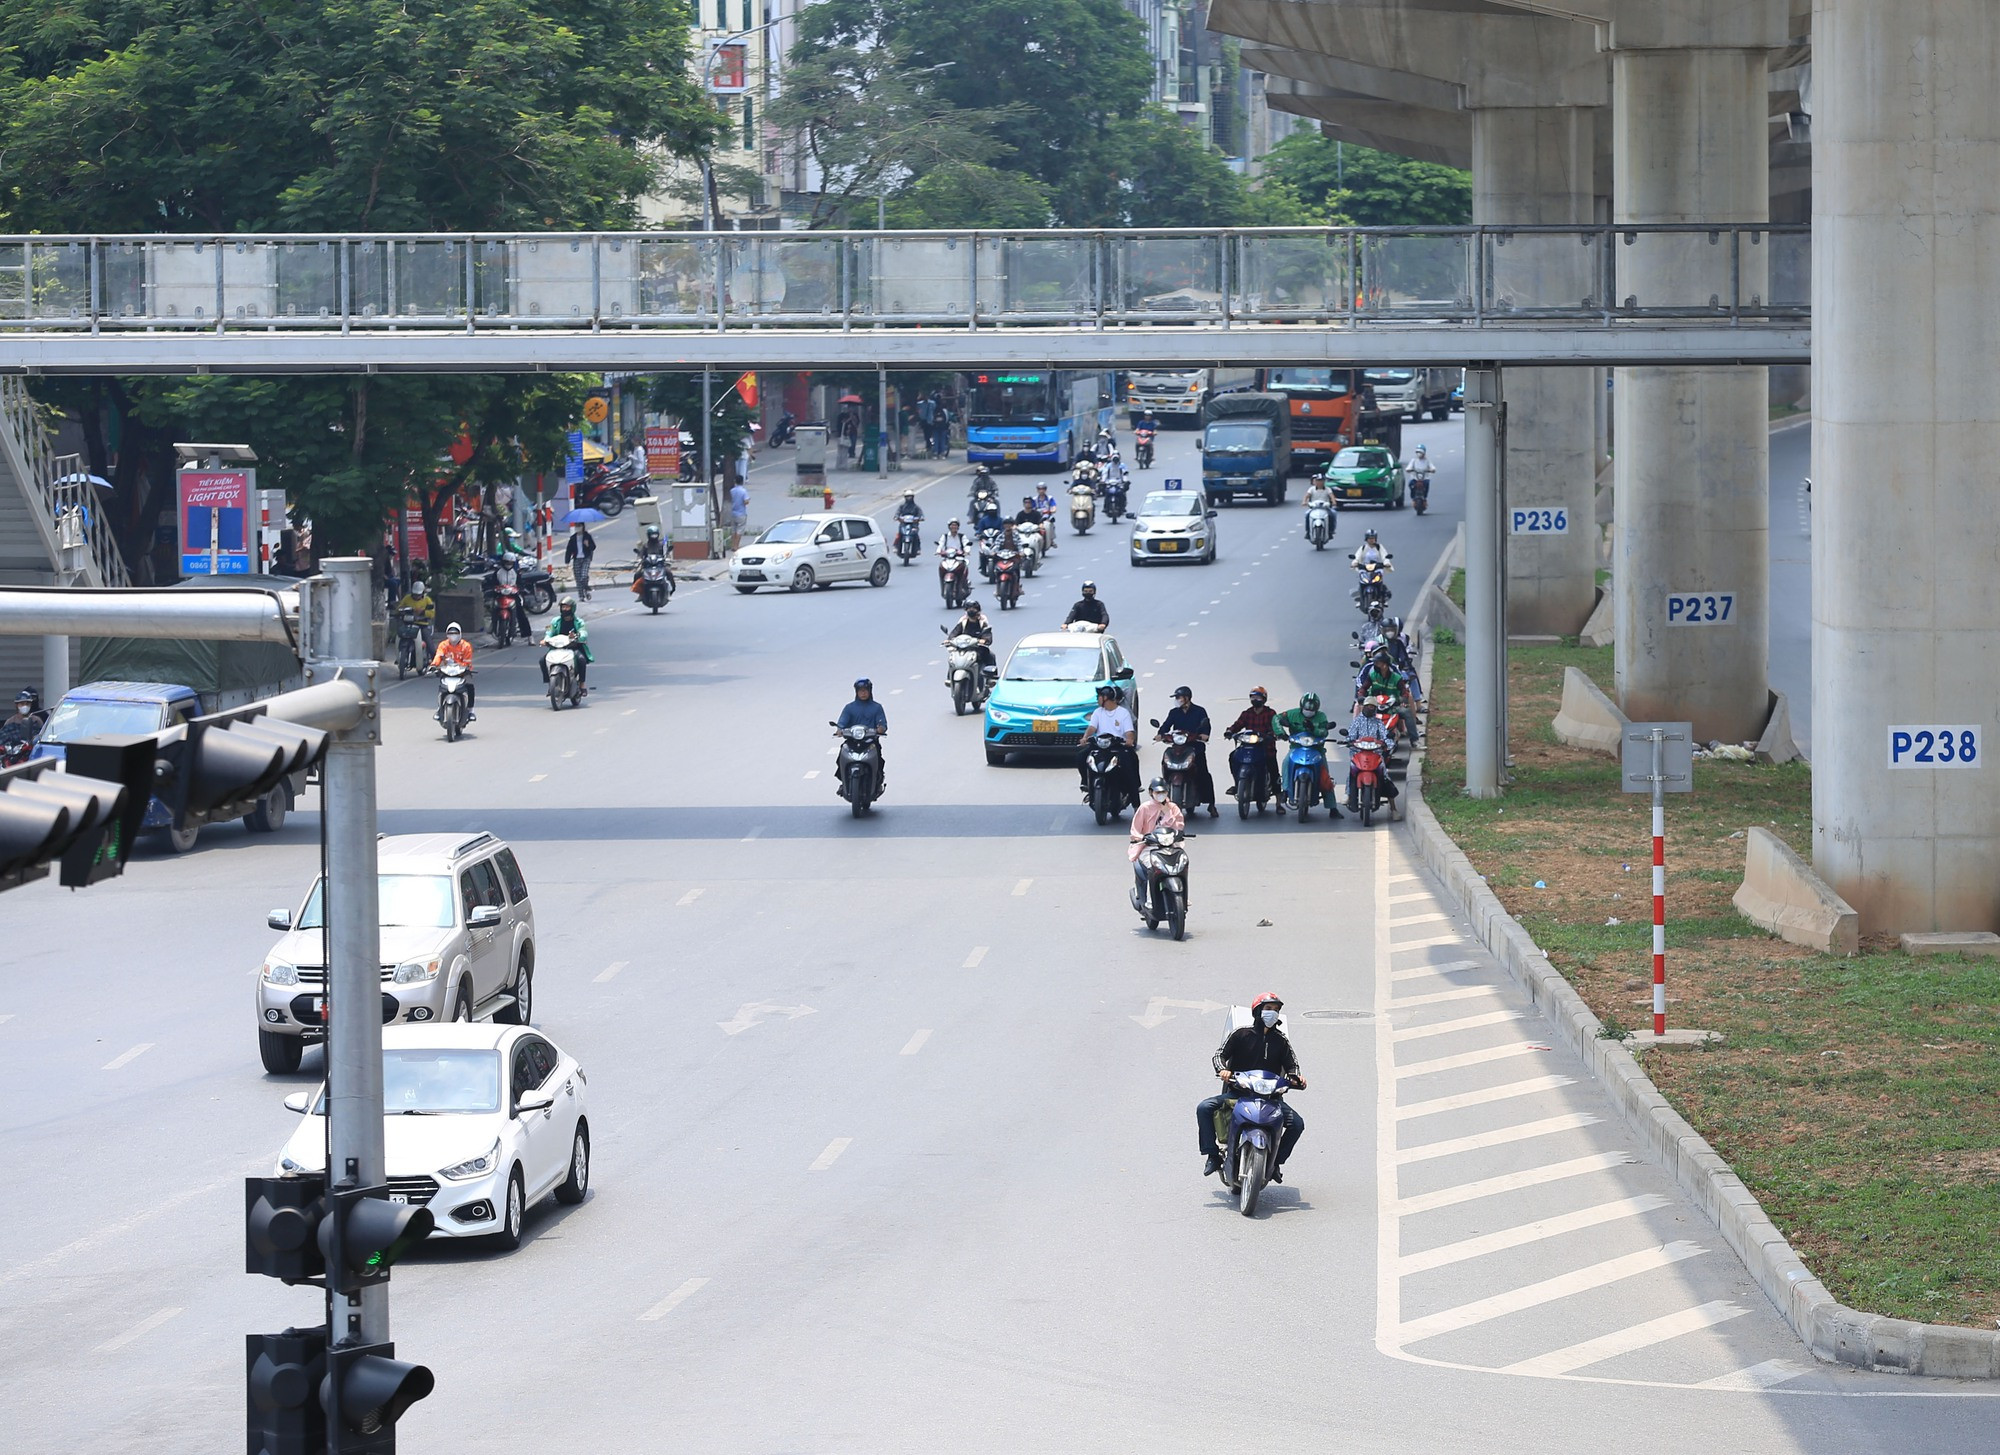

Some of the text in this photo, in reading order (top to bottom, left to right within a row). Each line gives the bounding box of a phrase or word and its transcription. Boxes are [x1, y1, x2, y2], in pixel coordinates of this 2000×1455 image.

[199, 477, 232, 486] TIẾT KIỆM
[188, 490, 240, 502] LIGHT BOX
[1513, 510, 1567, 532] P236
[1669, 596, 1733, 622] P237
[1892, 730, 1977, 763] P238
